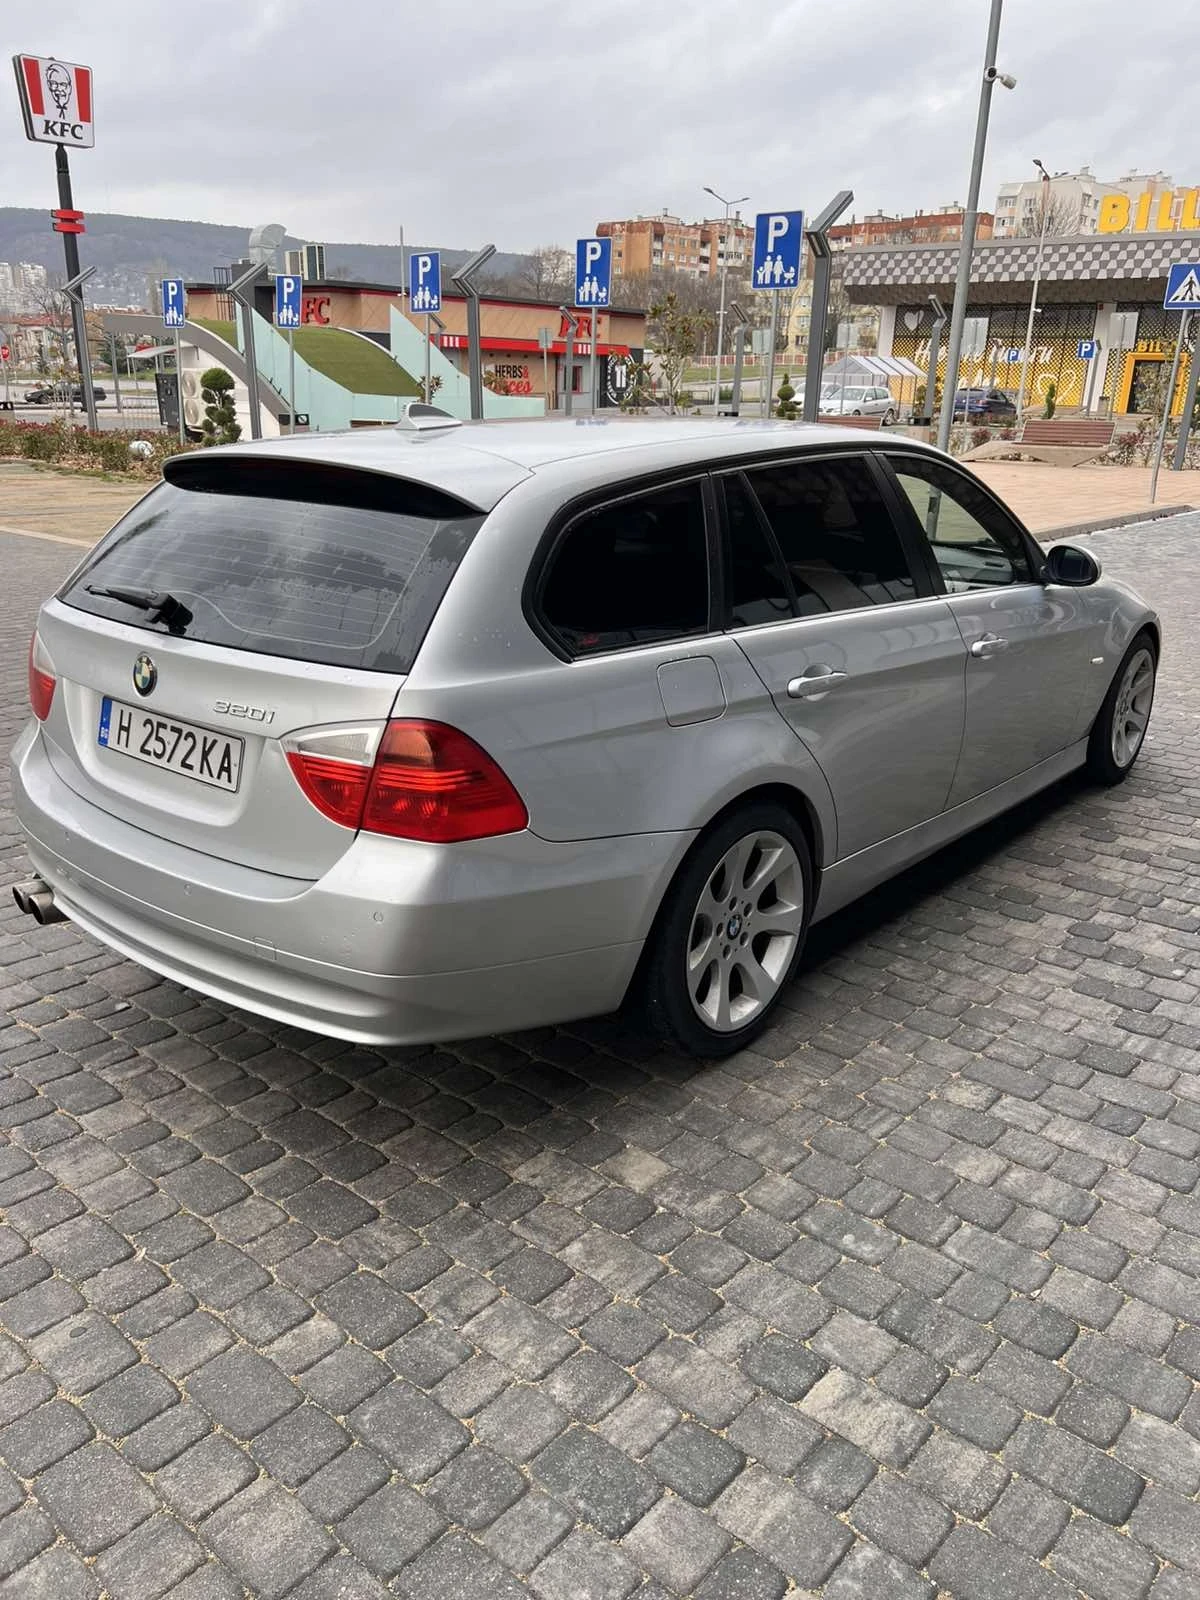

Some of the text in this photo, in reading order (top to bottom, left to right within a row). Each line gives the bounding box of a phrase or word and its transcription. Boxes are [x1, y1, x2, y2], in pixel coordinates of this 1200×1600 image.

[43, 120, 83, 140] KFC
[768, 216, 789, 252] P
[418, 255, 431, 285] P
[586, 242, 602, 274] P
[168, 282, 178, 304] P
[284, 277, 295, 303] P
[301, 297, 330, 325] FC
[1009, 350, 1017, 360] P
[1081, 343, 1091, 357] P
[117, 709, 132, 748] H
